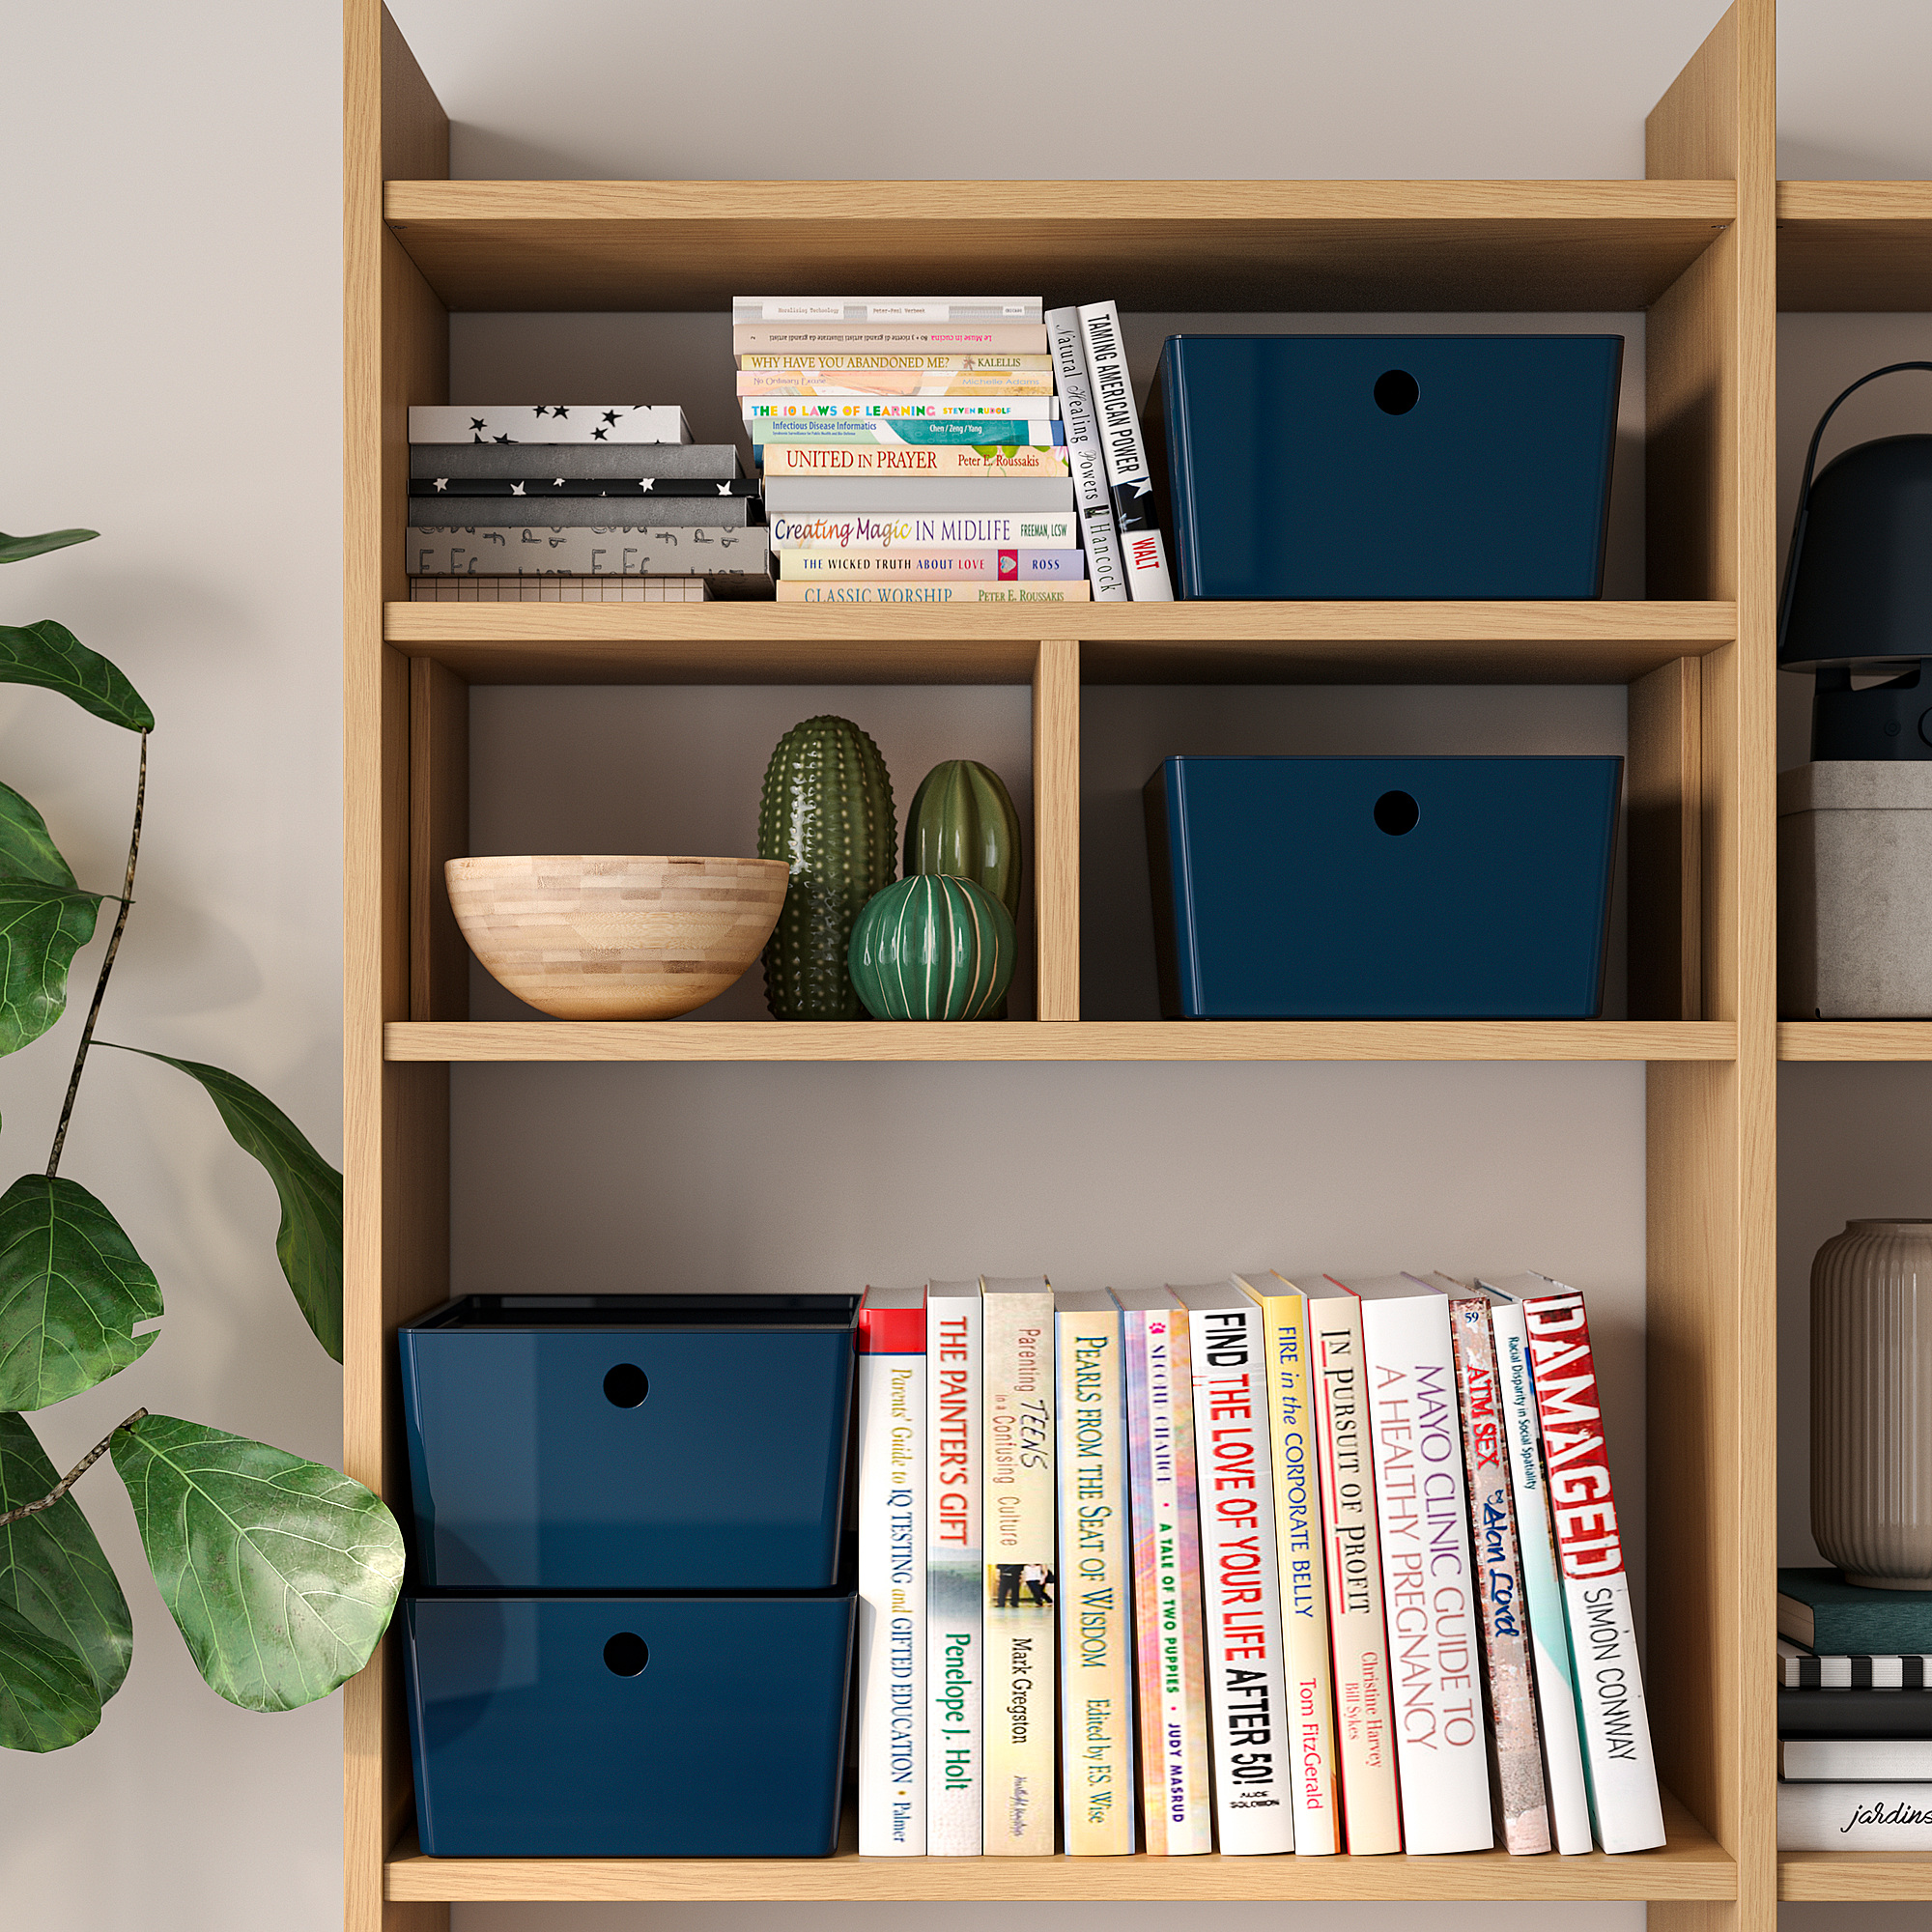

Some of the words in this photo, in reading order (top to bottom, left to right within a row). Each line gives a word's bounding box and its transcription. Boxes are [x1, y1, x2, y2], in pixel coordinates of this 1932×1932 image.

[1056, 325, 1083, 378] Natural
[1088, 314, 1117, 361] TAMING
[752, 356, 781, 368] WHY
[783, 356, 815, 368] HAVE
[819, 356, 845, 368] YOU
[846, 356, 924, 368] ABANDONED
[927, 356, 950, 368] ME?
[978, 357, 1021, 367] KALELLIS
[752, 406, 778, 416] THE
[783, 406, 797, 416] 10
[802, 406, 838, 416] LAWS
[842, 406, 860, 416] OF
[866, 406, 936, 416] LEARNING
[1066, 384, 1093, 444] Healing
[1097, 366, 1129, 427] AMERICAN
[773, 421, 808, 430] Infectious
[810, 421, 836, 430] Disease
[837, 421, 877, 430] Informatics
[929, 424, 945, 433] Chen
[949, 425, 964, 434] Zeng
[968, 425, 982, 434] Yang
[786, 450, 854, 469] UNITED
[858, 454, 872, 469] IN
[877, 450, 937, 469] PRAYER
[958, 454, 980, 467] Peter
[983, 454, 993, 467] E.
[996, 454, 1039, 467] Roussakis
[1078, 450, 1098, 500] Powers
[1110, 429, 1141, 475] POWER
[775, 518, 855, 547] Creating
[856, 518, 912, 547] Magic
[916, 521, 934, 541] IN
[941, 520, 1010, 541] MIDLIFE
[1020, 524, 1049, 539] FREEMAN,
[1051, 524, 1067, 537] LCSW
[1132, 536, 1160, 570] WALT
[803, 558, 823, 570] THE
[827, 558, 870, 570] WICKED
[875, 558, 912, 570] TRUTH
[917, 558, 953, 570] ABOUT
[958, 558, 985, 570] LOVE
[1032, 558, 1060, 570] ROSS
[1090, 524, 1122, 593] Hancock
[805, 587, 871, 601] CLASSIC
[877, 587, 952, 601] WORSHIP
[979, 589, 1005, 601] PETER
[1020, 589, 1065, 601] ROUSSAKIS
[939, 1316, 967, 1362] THE
[1204, 1312, 1248, 1367] FIND
[1464, 1312, 1480, 1323] 59
[1014, 1329, 1041, 1393] Parenting
[1278, 1326, 1298, 1364] FIRE
[1320, 1329, 1351, 1355] IN
[1508, 1337, 1520, 1362] Racial
[1075, 1336, 1109, 1403] PEARLS
[1151, 1345, 1169, 1409] SECOND
[1281, 1372, 1300, 1389] in
[1376, 1365, 1406, 1389] A
[1467, 1364, 1495, 1418] ATM
[1511, 1365, 1525, 1406] Disparity
[1209, 1373, 1252, 1422] THE
[1282, 1394, 1302, 1426] the
[1414, 1364, 1453, 1463] MAYO
[1517, 1408, 1526, 1417] in
[939, 1370, 967, 1486] PAINTER'S
[1019, 1400, 1050, 1469] TEENS
[1076, 1408, 1103, 1459] FROM
[1323, 1368, 1360, 1474] PURSUIT
[1519, 1419, 1532, 1445] Social
[1525, 1295, 1624, 1576] DAMAGED
[891, 1427, 913, 1464] Guide
[992, 1416, 1017, 1484] Confusing
[1153, 1415, 1173, 1483] CHANCE
[1211, 1428, 1256, 1491] LOVE
[1473, 1422, 1499, 1470] SEX
[891, 1470, 910, 1484] to
[1077, 1464, 1103, 1500] THE
[1378, 1399, 1421, 1541] HEALTHY
[1520, 1447, 1538, 1491] Spatiality
[887, 1489, 913, 1507] IQ
[1215, 1497, 1259, 1529] OF
[1285, 1433, 1310, 1552] CORPORATE
[1340, 1483, 1363, 1514] OF
[939, 1493, 967, 1546] GIFT
[999, 1497, 1020, 1547] Culture
[1078, 1505, 1113, 1549] SEAT
[1159, 1523, 1173, 1532] A
[1423, 1472, 1463, 1577] CLINIC
[1483, 1501, 1510, 1564] Alan
[891, 1513, 913, 1584] TESTING
[1078, 1557, 1105, 1582] OF
[1159, 1538, 1175, 1569] TALE
[1218, 1536, 1263, 1605] YOUR
[1335, 1524, 1370, 1615] PROFIT
[892, 1588, 913, 1613] and
[1161, 1576, 1175, 1593] OF
[1292, 1559, 1314, 1619] BELLY
[1490, 1568, 1520, 1638] Lord
[1080, 1587, 1115, 1668] WISDOM
[1163, 1600, 1177, 1631] TWO
[1222, 1611, 1266, 1662] LIFE
[1434, 1586, 1471, 1691] GUIDE
[1584, 1588, 1621, 1662] SIMON
[891, 1618, 913, 1679] GIFTED
[1011, 1638, 1033, 1675] Mark
[1164, 1637, 1180, 1694] PUPPIES
[1391, 1552, 1437, 1750] PREGNANCY
[935, 1633, 973, 1721] Penelope
[1299, 1677, 1318, 1717] Tom
[1345, 1682, 1360, 1704] Bill
[1362, 1652, 1381, 1715] Christine
[1007, 1679, 1034, 1745] Gregston
[1086, 1698, 1111, 1742] Edited
[1226, 1667, 1272, 1747] AFTER
[1344, 1706, 1363, 1741] Sykes
[1443, 1698, 1476, 1747] TO
[1596, 1667, 1637, 1760] CONWAY
[891, 1683, 913, 1783] EDUCATION
[941, 1729, 971, 1741] J.
[1082, 1745, 1112, 1760] by
[1168, 1723, 1182, 1757] JUDY
[1365, 1719, 1383, 1769] Harvey
[945, 1748, 974, 1790] Holt
[1231, 1752, 1274, 1785] 50!
[1302, 1723, 1323, 1810] FitzGerald
[1088, 1791, 1113, 1824] Wise
[1169, 1764, 1184, 1823] MASRUD
[893, 1802, 911, 1843] Palmer
